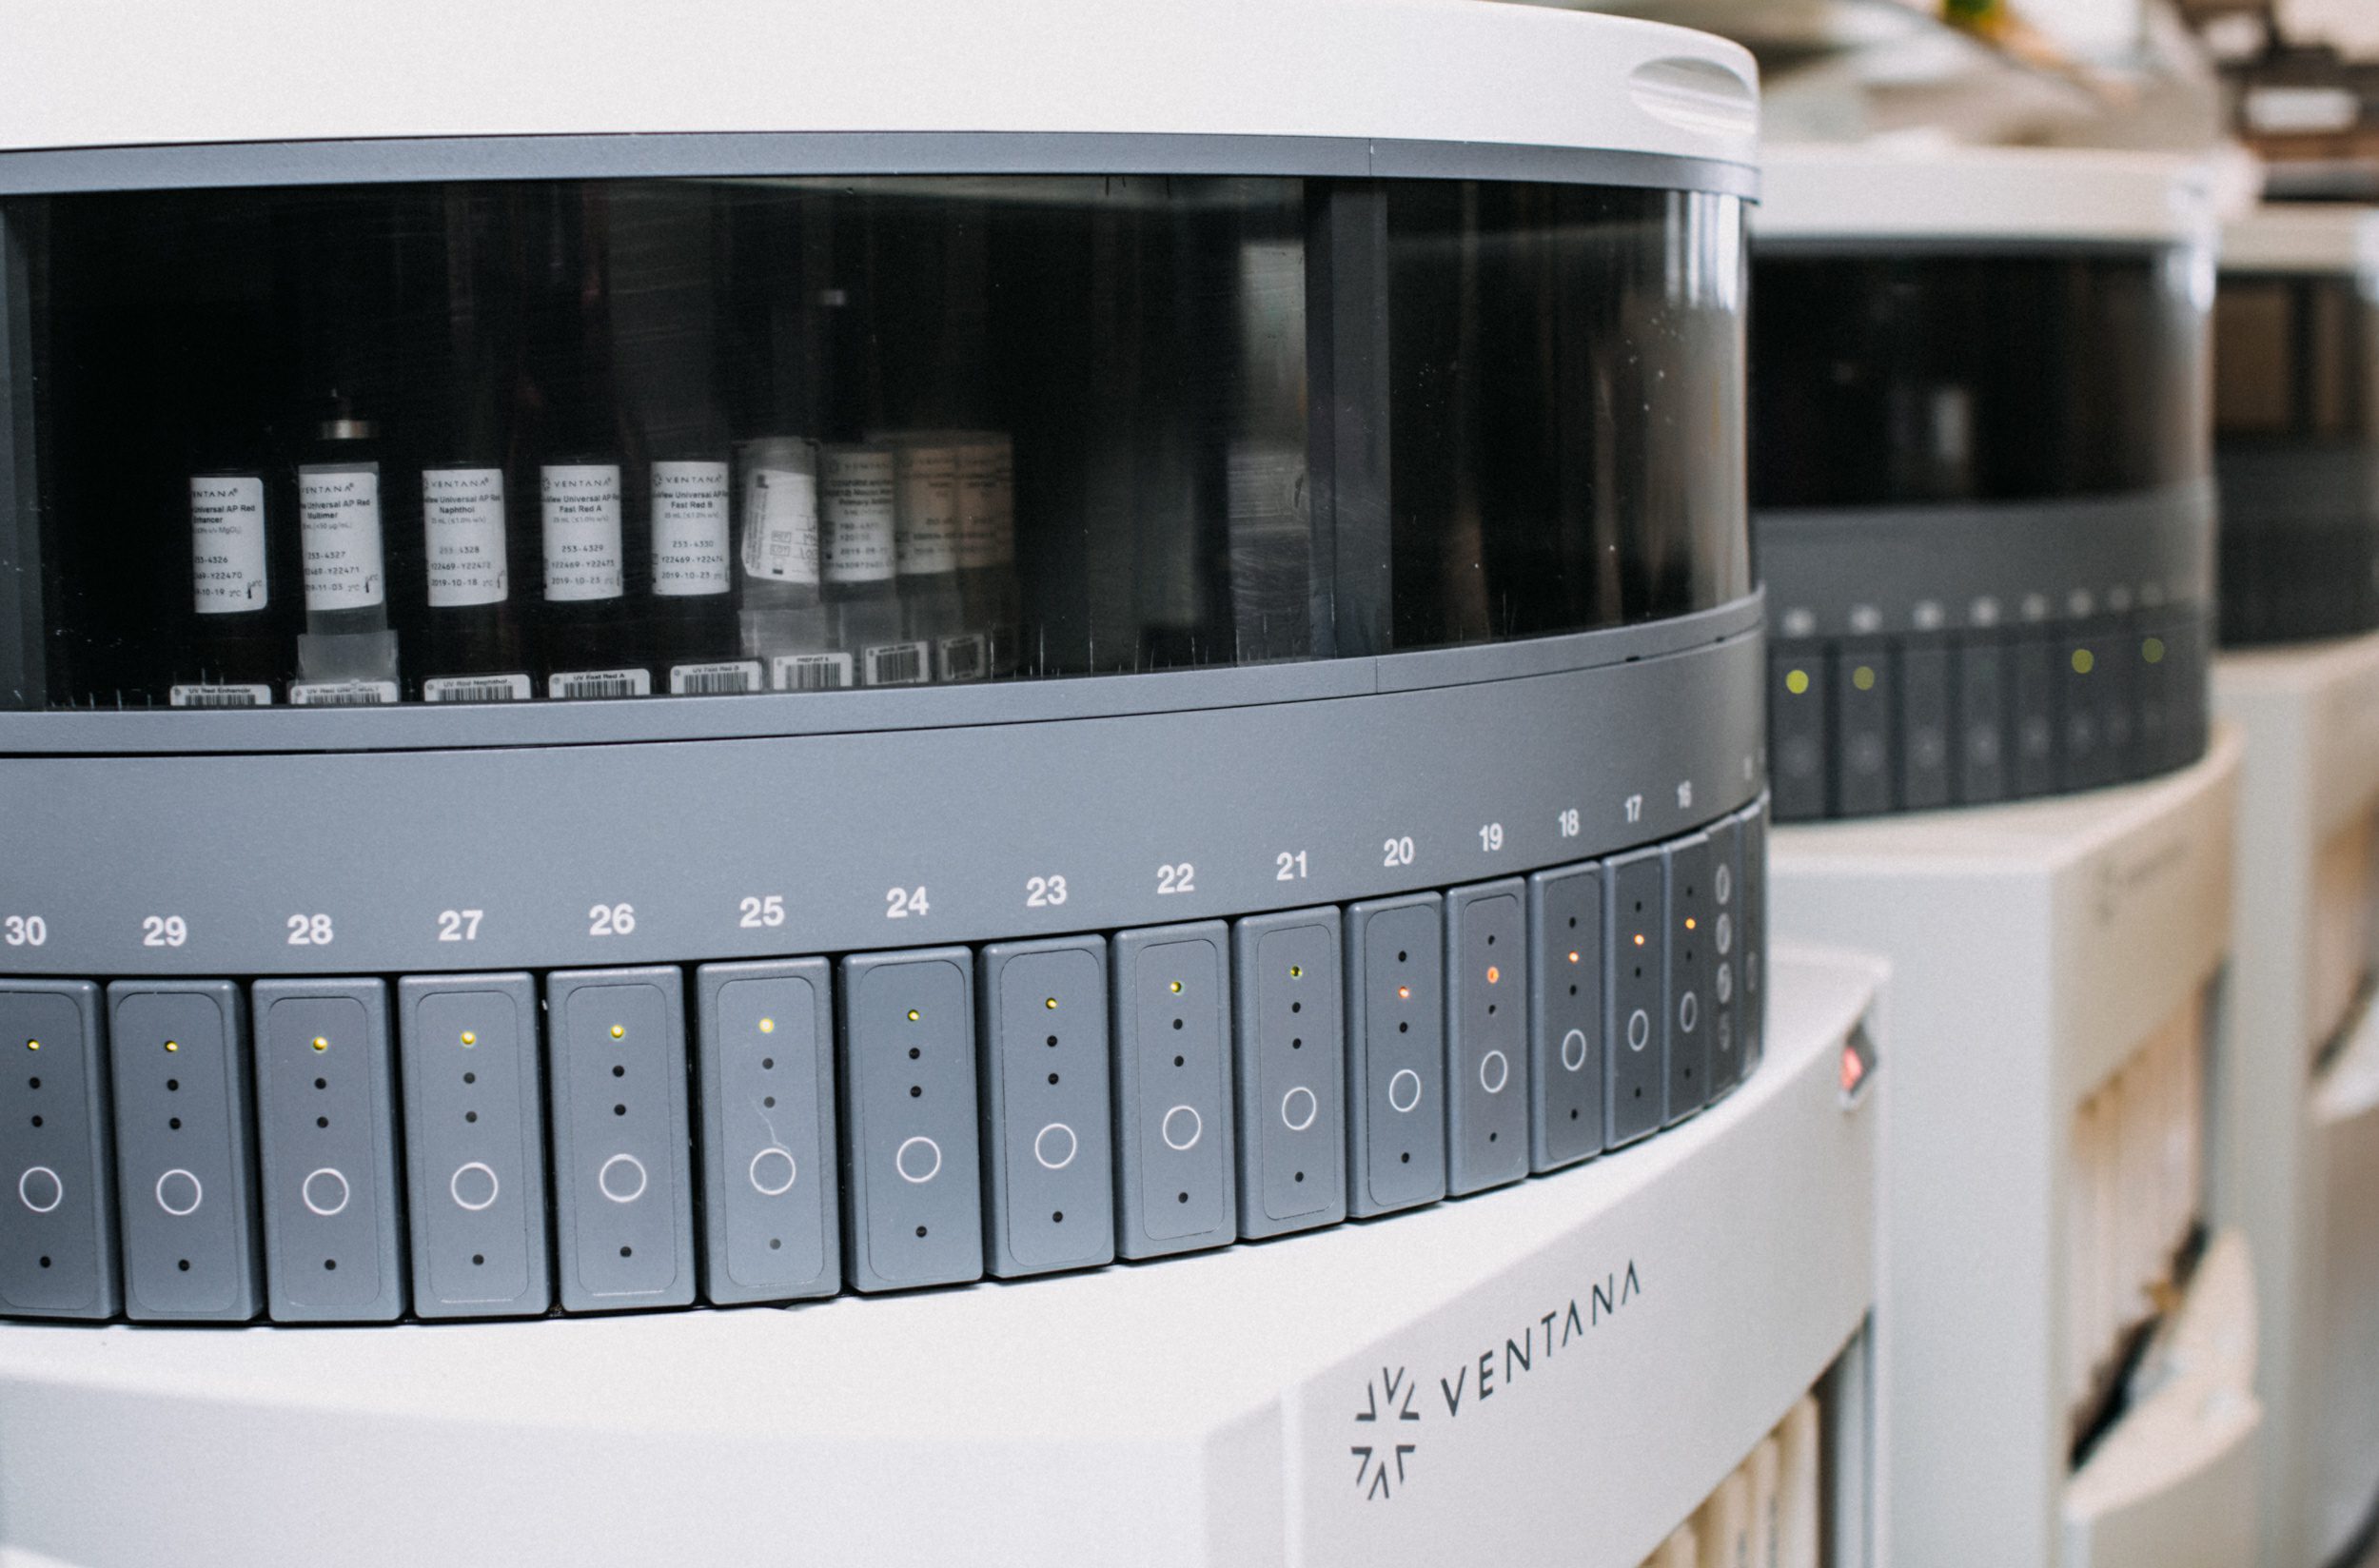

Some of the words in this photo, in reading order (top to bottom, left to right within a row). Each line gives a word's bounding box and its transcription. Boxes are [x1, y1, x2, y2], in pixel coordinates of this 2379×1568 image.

[356, 499, 371, 507] Red
[440, 496, 477, 504] Universal
[559, 505, 577, 514] Fast
[563, 495, 600, 503] Universal
[671, 500, 688, 509] Fast
[689, 500, 706, 509] Red
[675, 490, 712, 499] Universal
[439, 506, 476, 515] Naphthol
[561, 544, 604, 553] 253-4329
[1558, 808, 1580, 838] 18
[1624, 794, 1642, 823] 17
[1383, 836, 1414, 867] 20
[1479, 822, 1504, 852] 19
[1157, 863, 1195, 894] 22
[1276, 850, 1308, 881] 21
[886, 887, 930, 918] 24
[1027, 875, 1068, 907] 23
[438, 910, 484, 941] 27
[589, 903, 636, 935] 26
[739, 895, 785, 928] 25
[5, 915, 47, 947] 30
[143, 915, 187, 947] 29
[287, 913, 334, 945] 28
[1440, 1259, 1640, 1417] VENTANA
